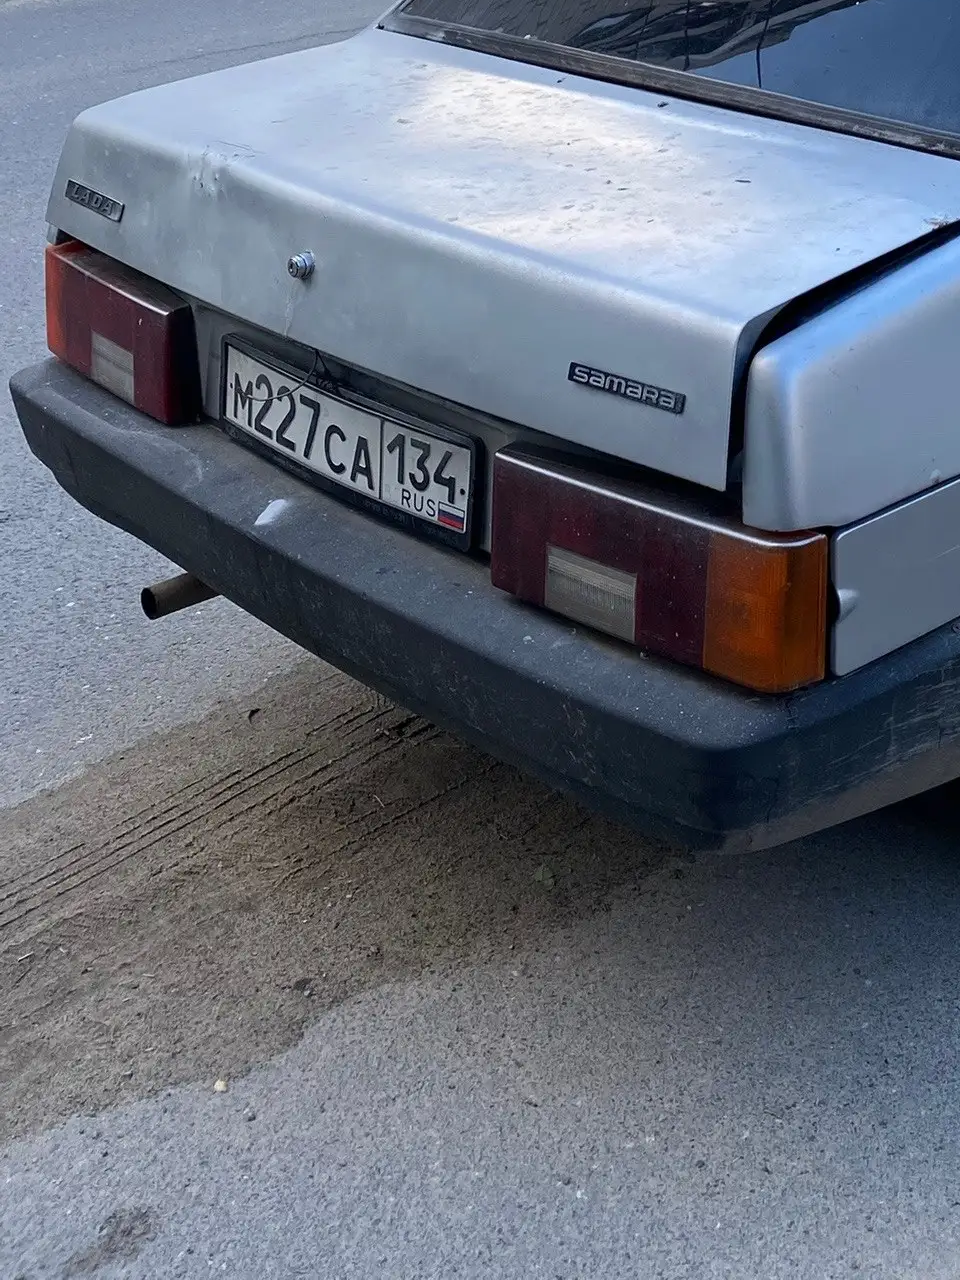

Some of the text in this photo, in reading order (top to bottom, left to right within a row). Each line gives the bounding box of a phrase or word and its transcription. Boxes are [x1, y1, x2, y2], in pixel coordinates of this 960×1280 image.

[71, 184, 114, 216] LADA
[386, 433, 456, 504] 134
[401, 488, 436, 517] RUS
